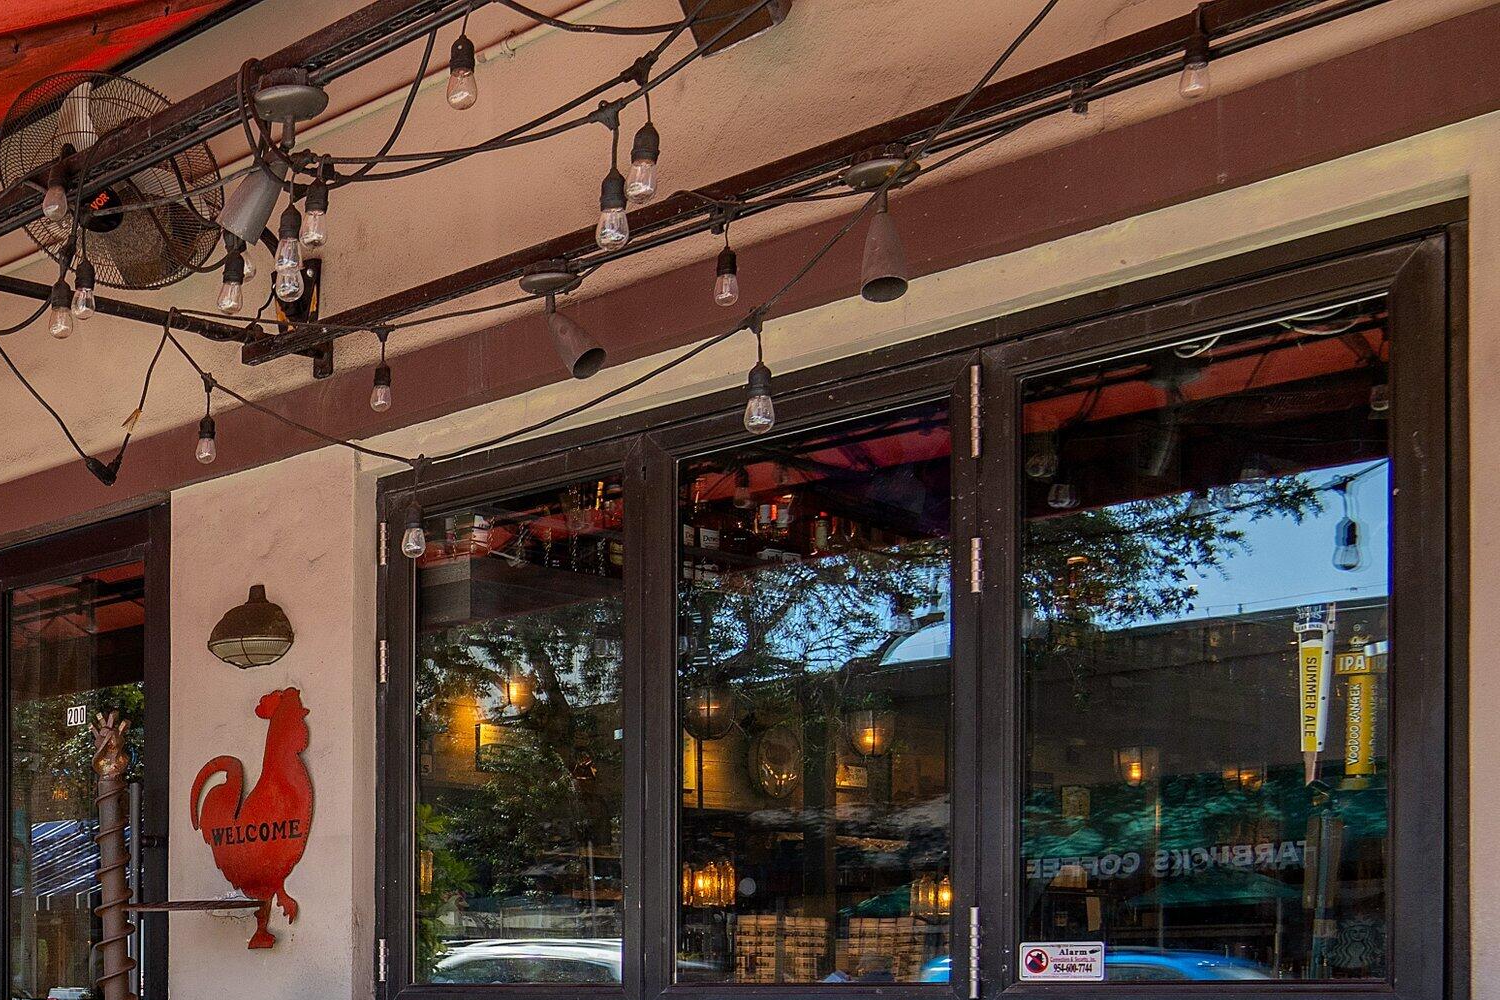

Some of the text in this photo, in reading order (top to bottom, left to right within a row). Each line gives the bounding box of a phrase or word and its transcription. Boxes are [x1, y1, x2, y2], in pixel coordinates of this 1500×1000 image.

[1339, 655, 1366, 672] IPA
[1304, 657, 1318, 737] SUMMER ALE
[1347, 683, 1362, 723] RANGER
[68, 707, 85, 725] 200
[212, 819, 302, 847] WELCOME
[1058, 948, 1088, 956] Alarm
